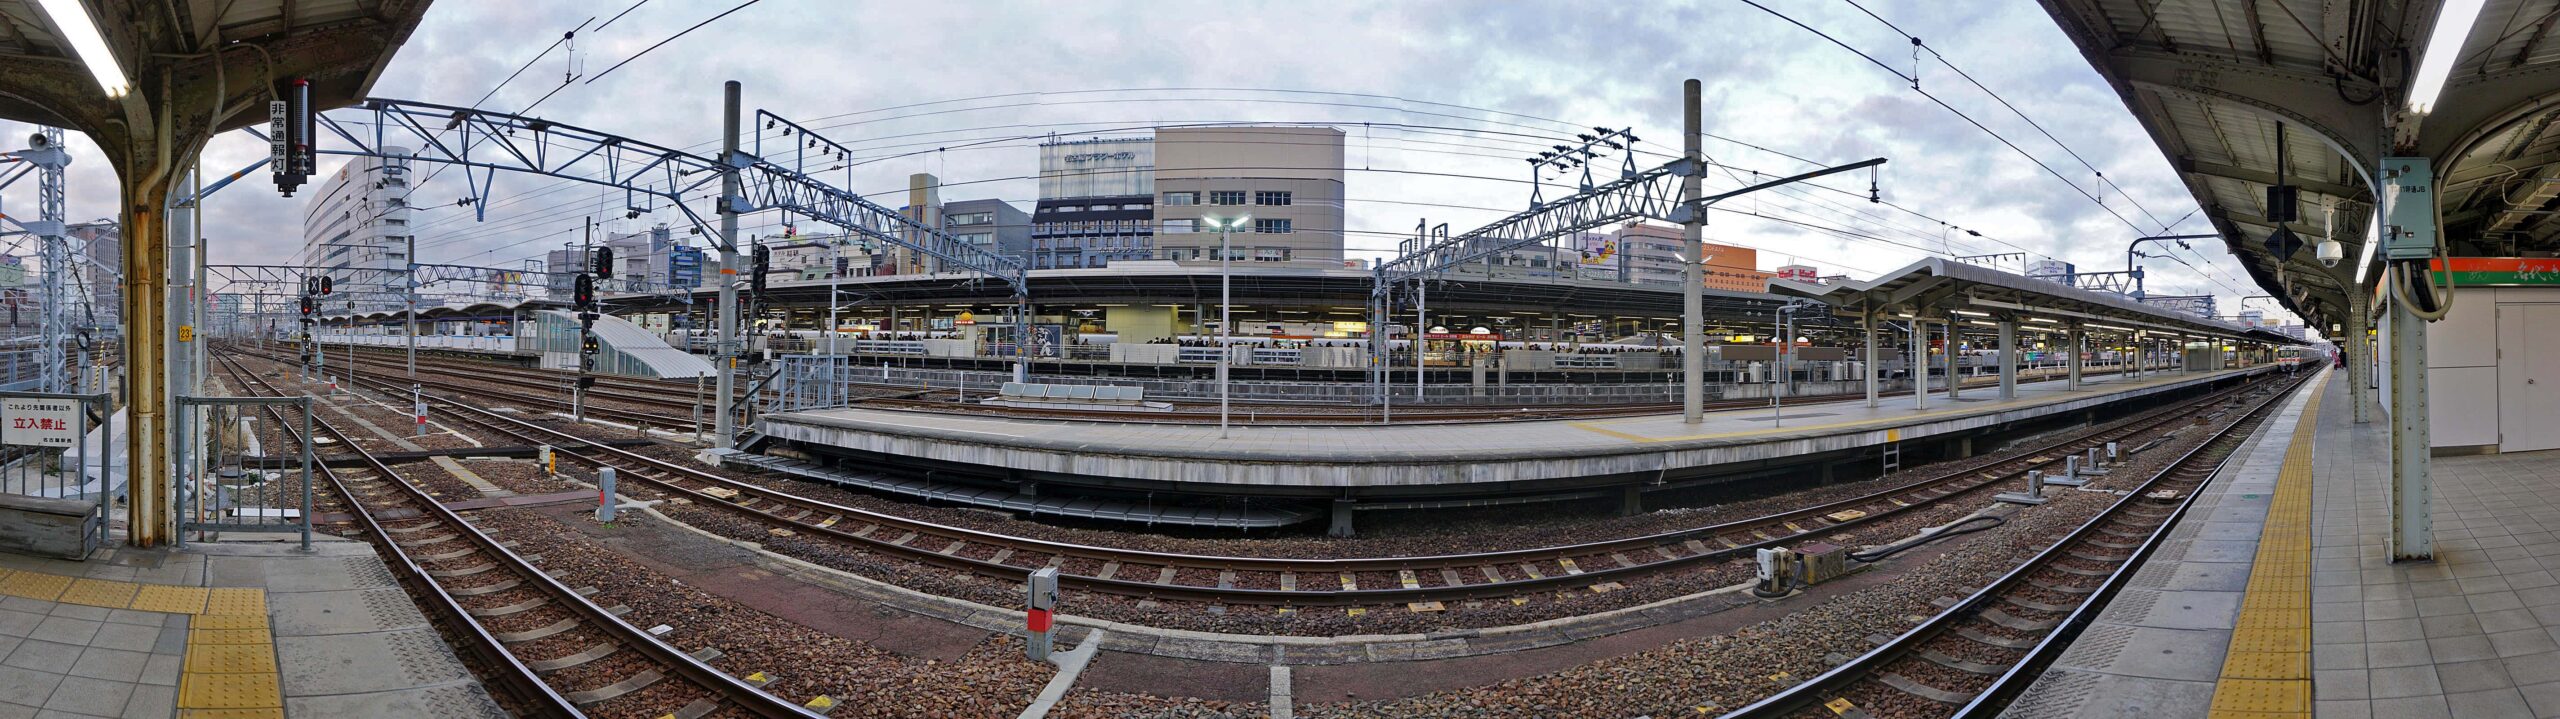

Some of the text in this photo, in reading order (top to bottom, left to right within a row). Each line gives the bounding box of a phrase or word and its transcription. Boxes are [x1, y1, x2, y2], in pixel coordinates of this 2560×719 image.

[271, 103, 285, 170] 非常通報灯
[13, 417, 67, 430] 立入禁止
